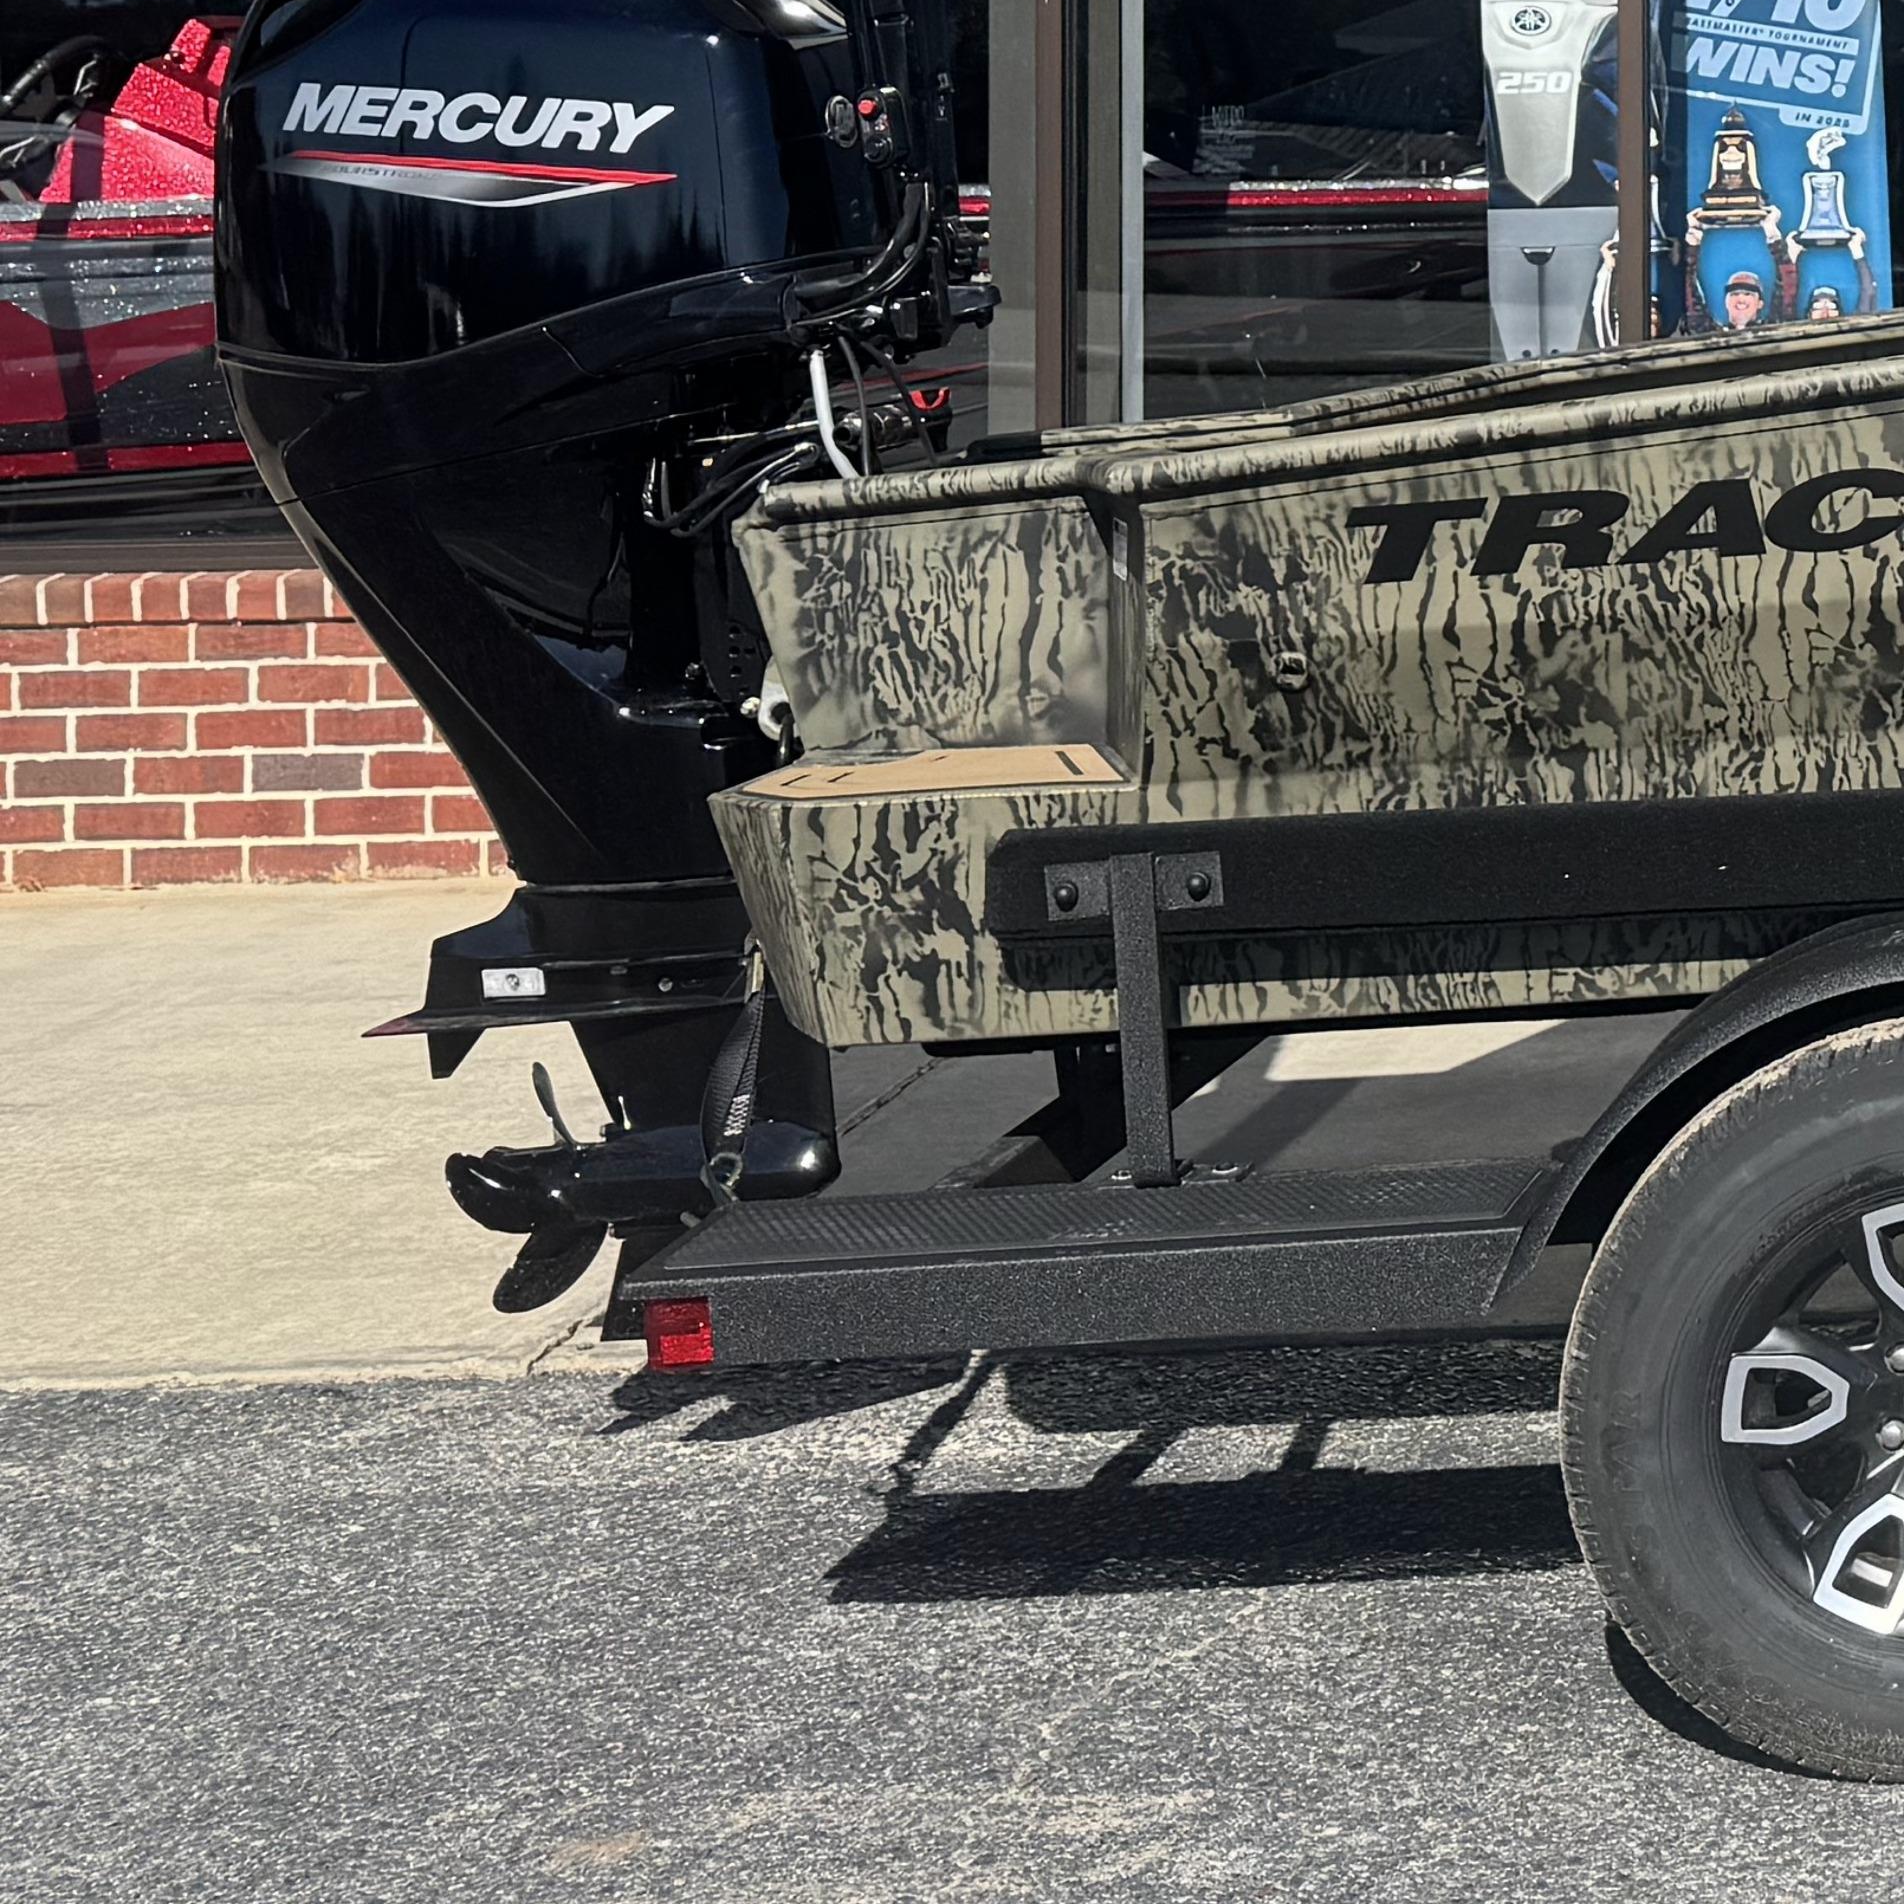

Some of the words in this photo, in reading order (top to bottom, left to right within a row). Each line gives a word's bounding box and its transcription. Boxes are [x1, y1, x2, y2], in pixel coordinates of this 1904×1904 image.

[1768, 29, 1849, 51] TOURNAMENT
[1672, 36, 1856, 98] WINS!
[1497, 71, 1572, 94] 250
[282, 82, 675, 154] MERCURY
[1794, 112, 1811, 123] IN
